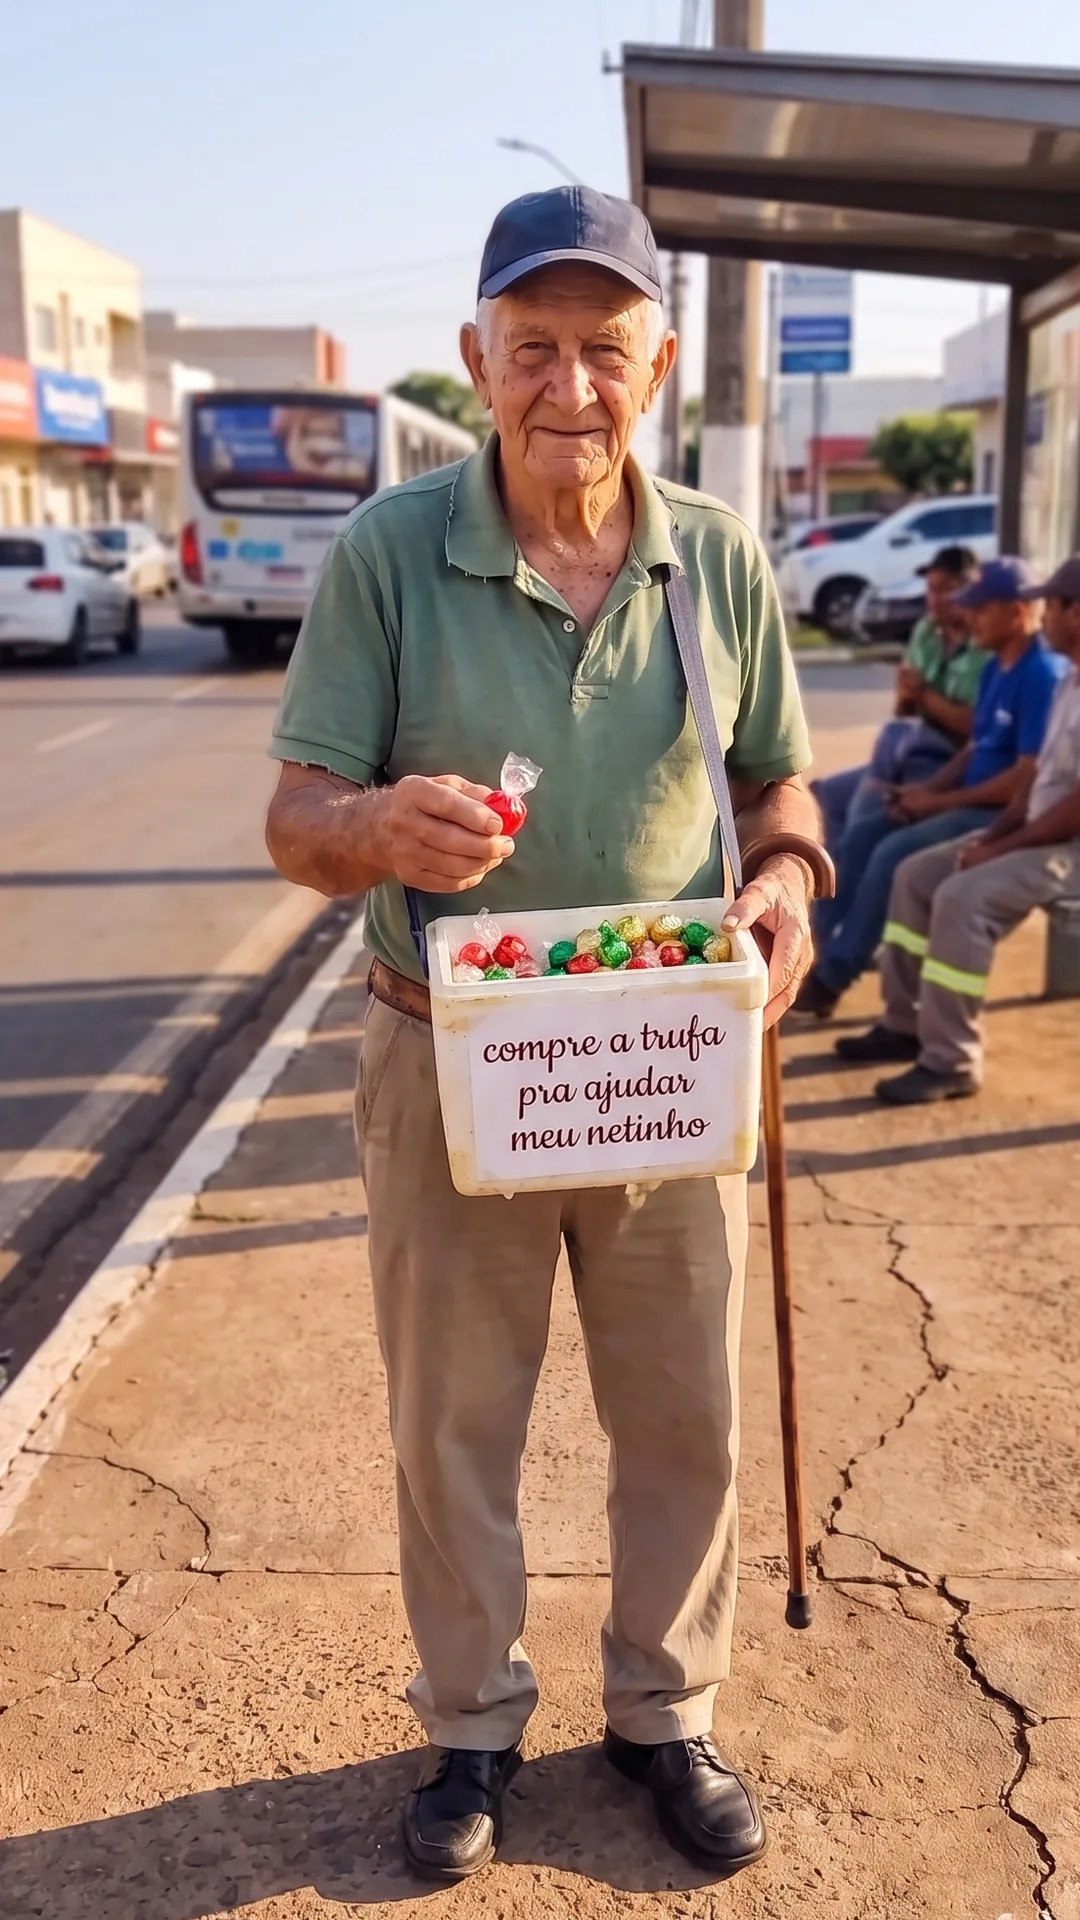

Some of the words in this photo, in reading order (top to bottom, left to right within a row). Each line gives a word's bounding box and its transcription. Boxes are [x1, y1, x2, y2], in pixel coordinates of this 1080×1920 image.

[483, 1035, 603, 1073] compre
[609, 1033, 636, 1054] a
[640, 1014, 727, 1062] trufa
[518, 1083, 578, 1121] pra
[584, 1065, 696, 1115] ajudar
[511, 1128, 582, 1152] meu
[587, 1108, 711, 1146] netinho
